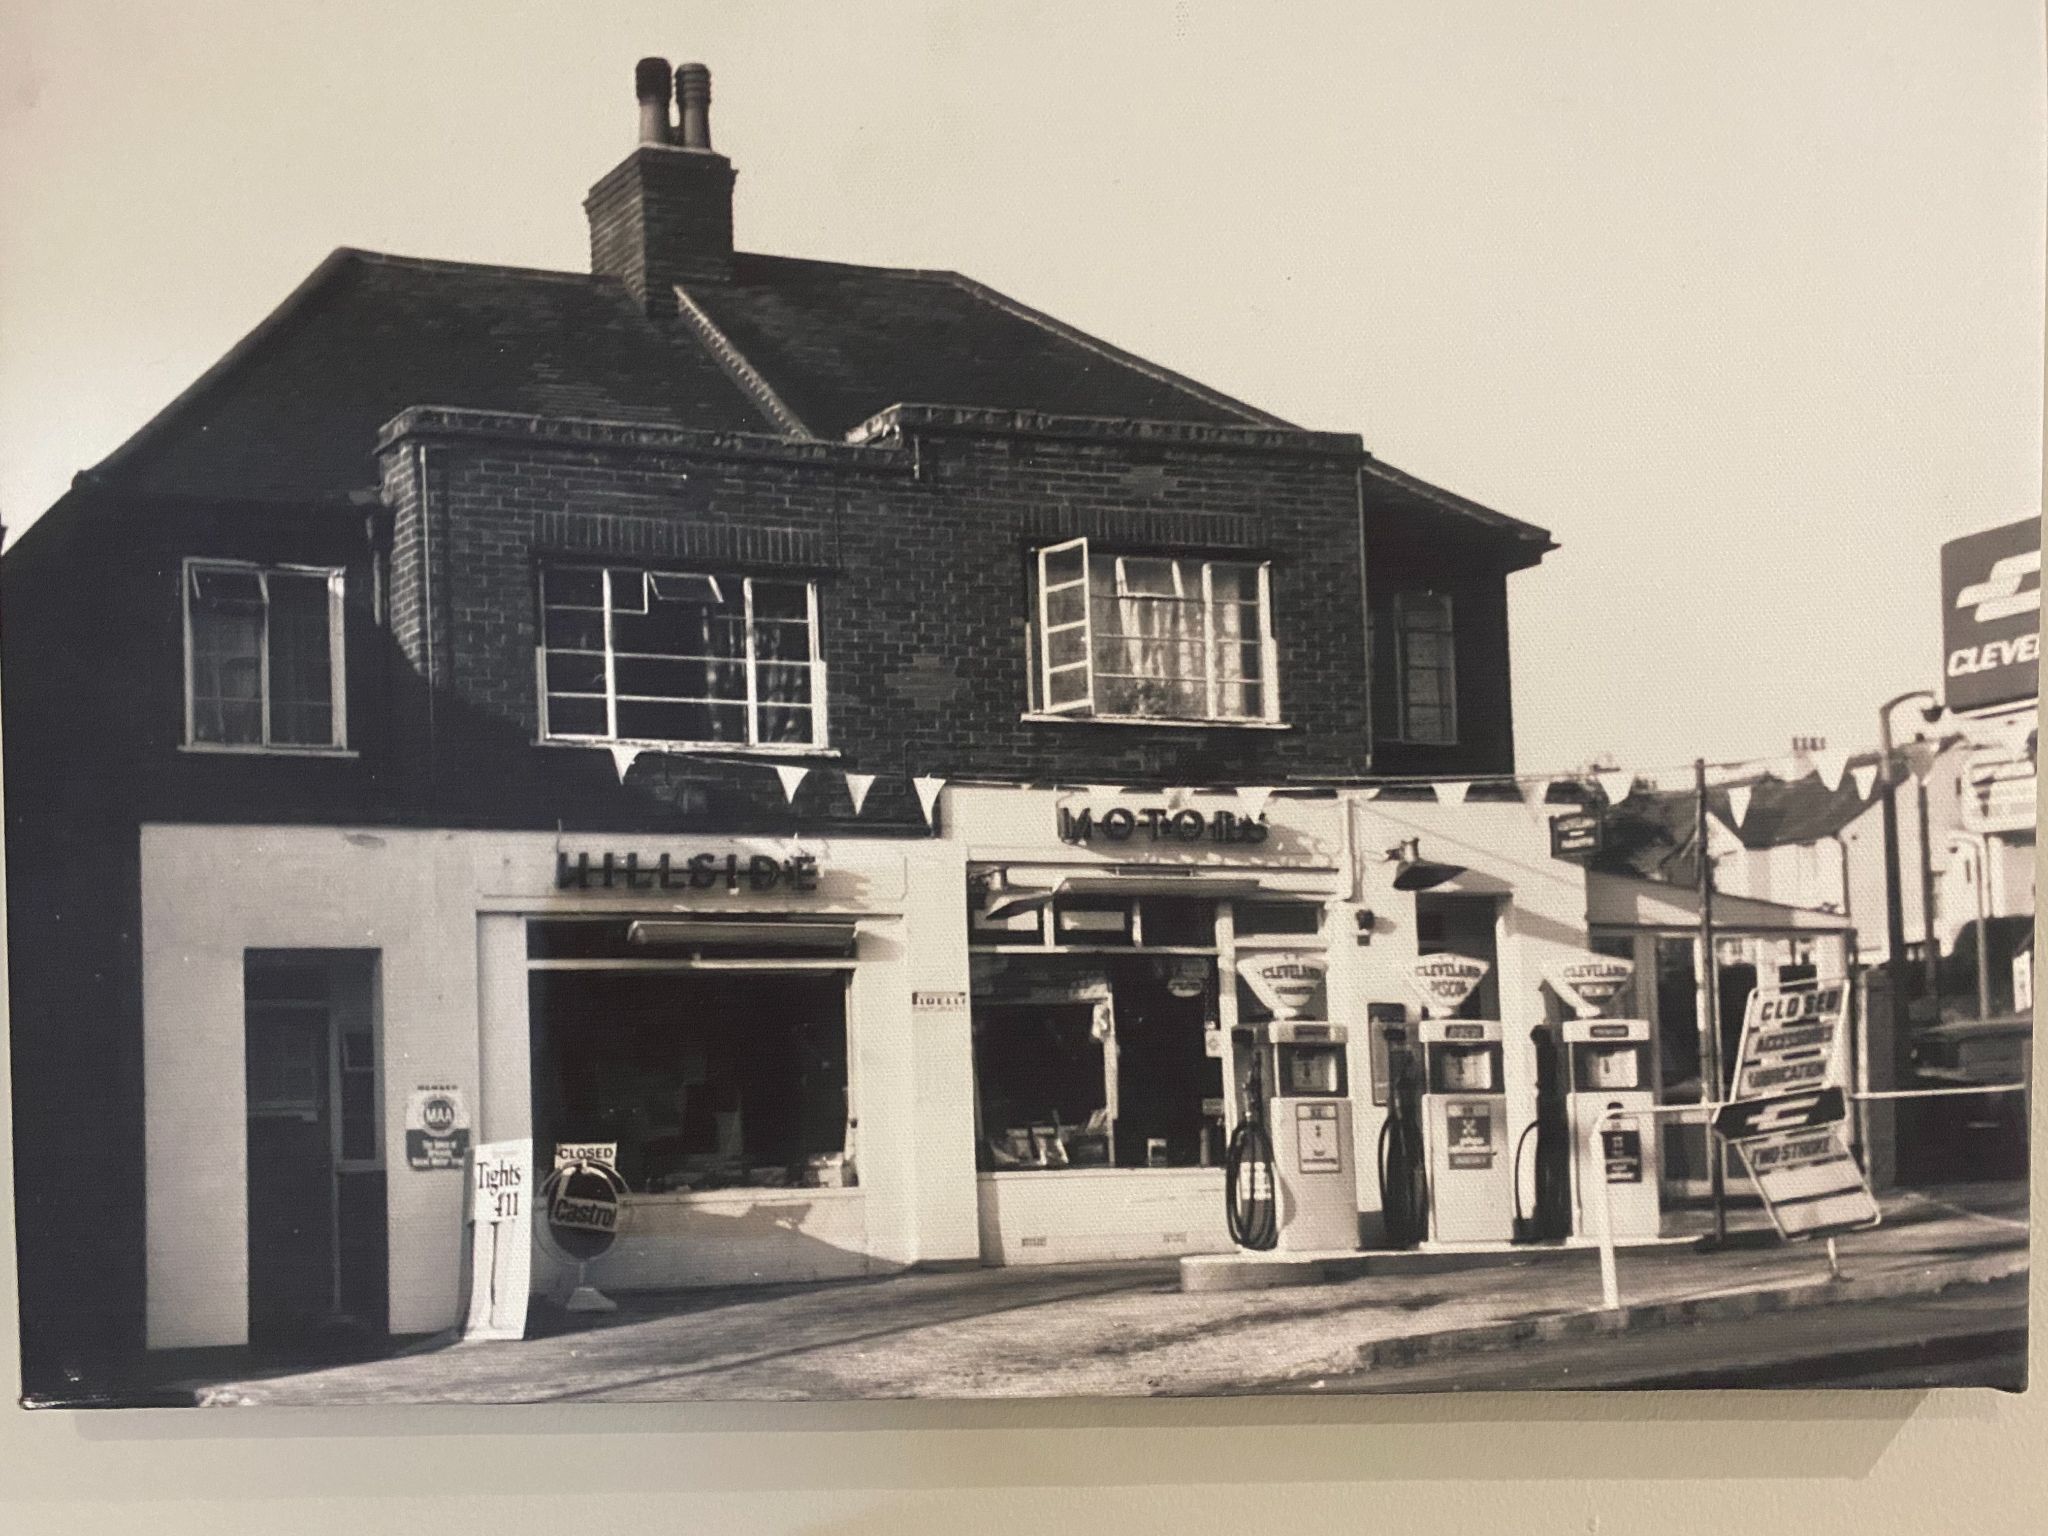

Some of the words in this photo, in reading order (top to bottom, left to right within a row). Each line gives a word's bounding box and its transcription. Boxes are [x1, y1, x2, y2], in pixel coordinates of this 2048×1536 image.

[1947, 633, 2040, 677] CLEVE
[556, 852, 818, 890] HILLSIDE
[1760, 990, 1841, 1021] CLOSED
[560, 1147, 614, 1160] CLOSED
[476, 1160, 521, 1196] Tights
